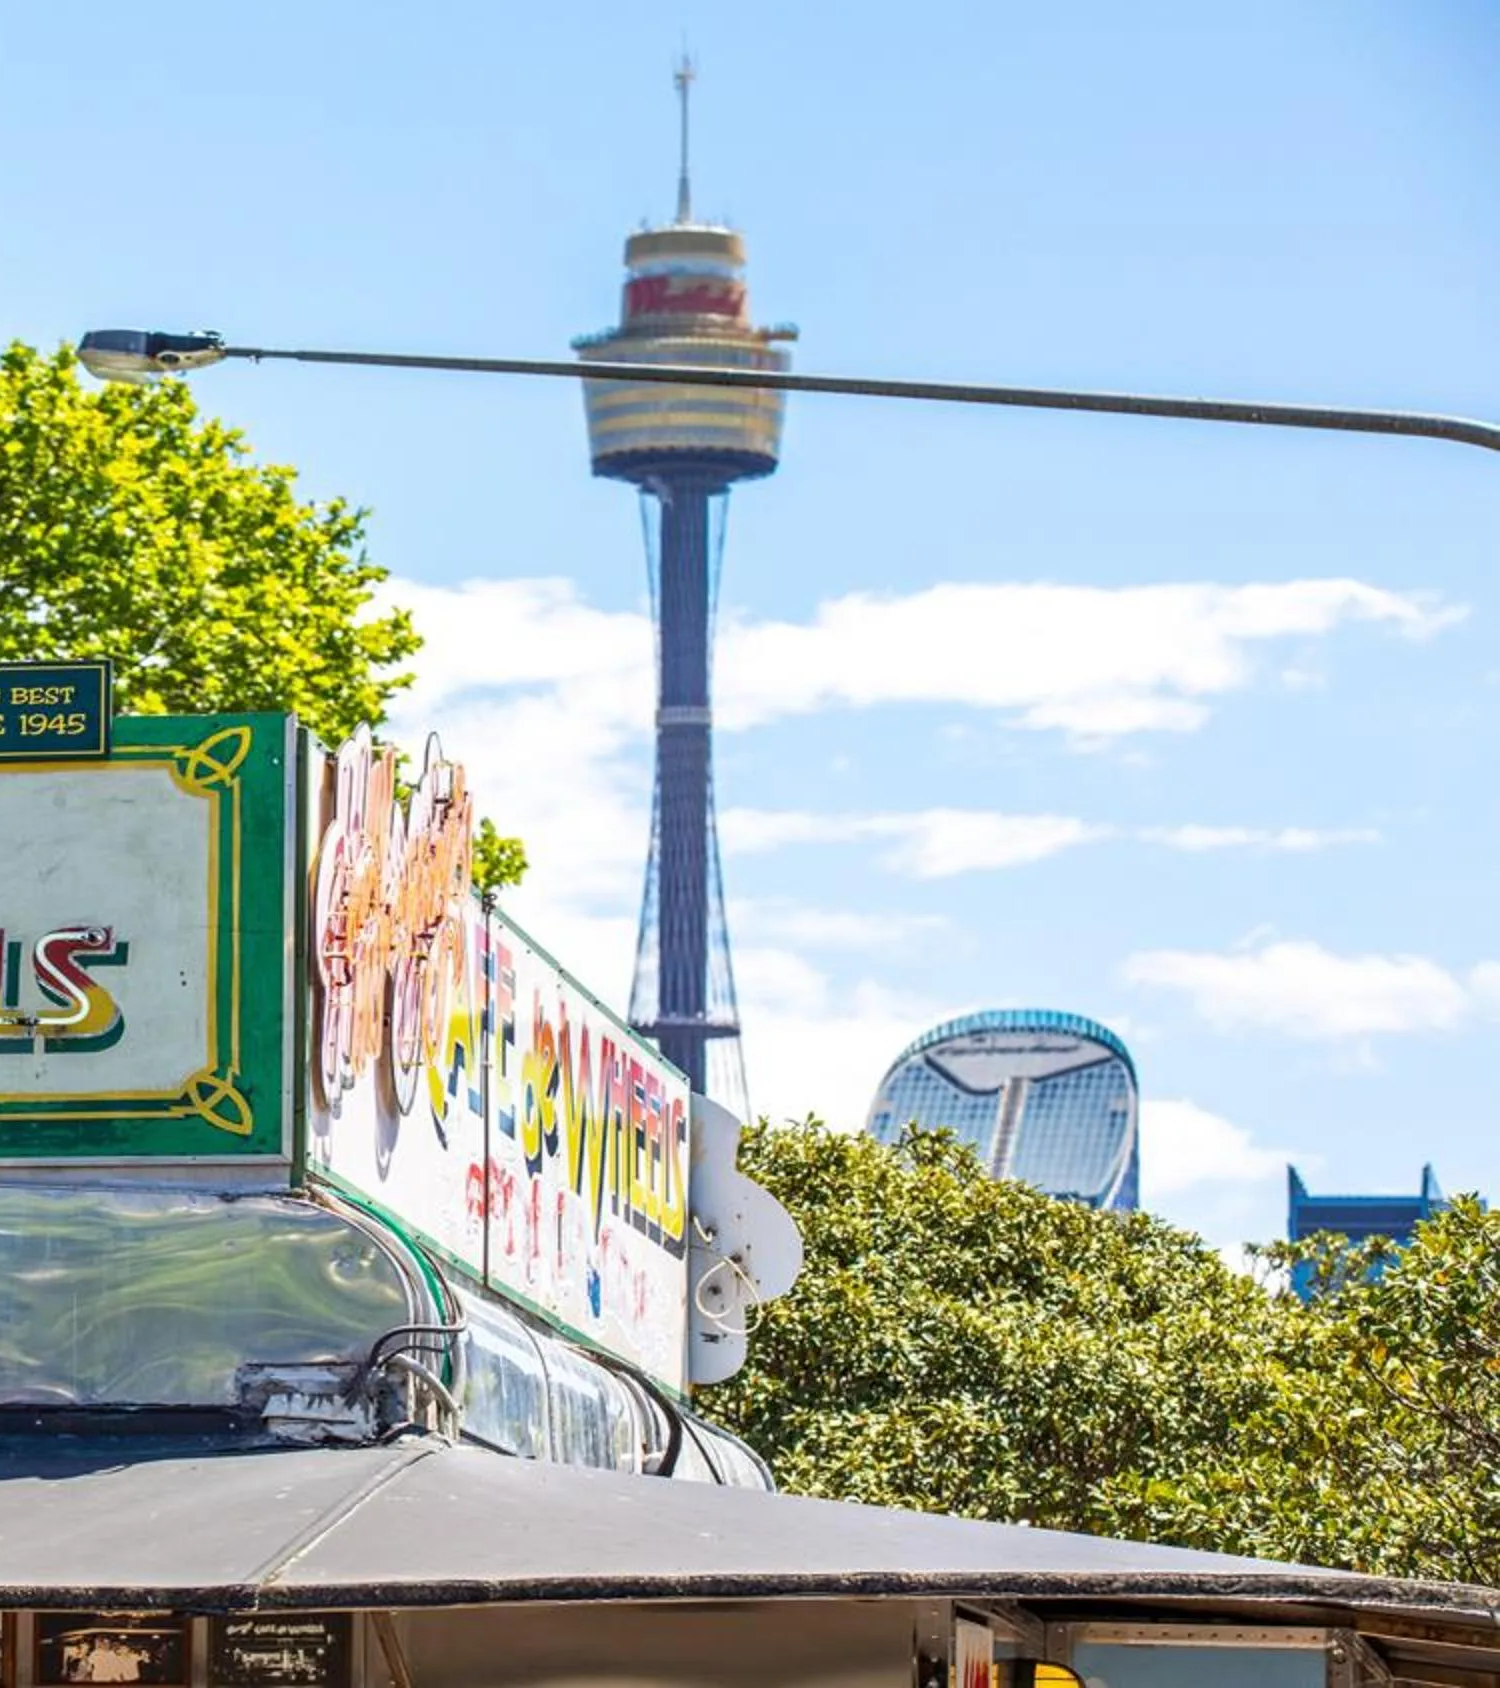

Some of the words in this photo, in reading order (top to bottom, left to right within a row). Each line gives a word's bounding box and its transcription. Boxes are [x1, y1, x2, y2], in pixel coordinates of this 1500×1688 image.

[10, 685, 75, 706] BEST
[18, 712, 87, 737] 1945
[558, 1002, 688, 1262] WHEELS
